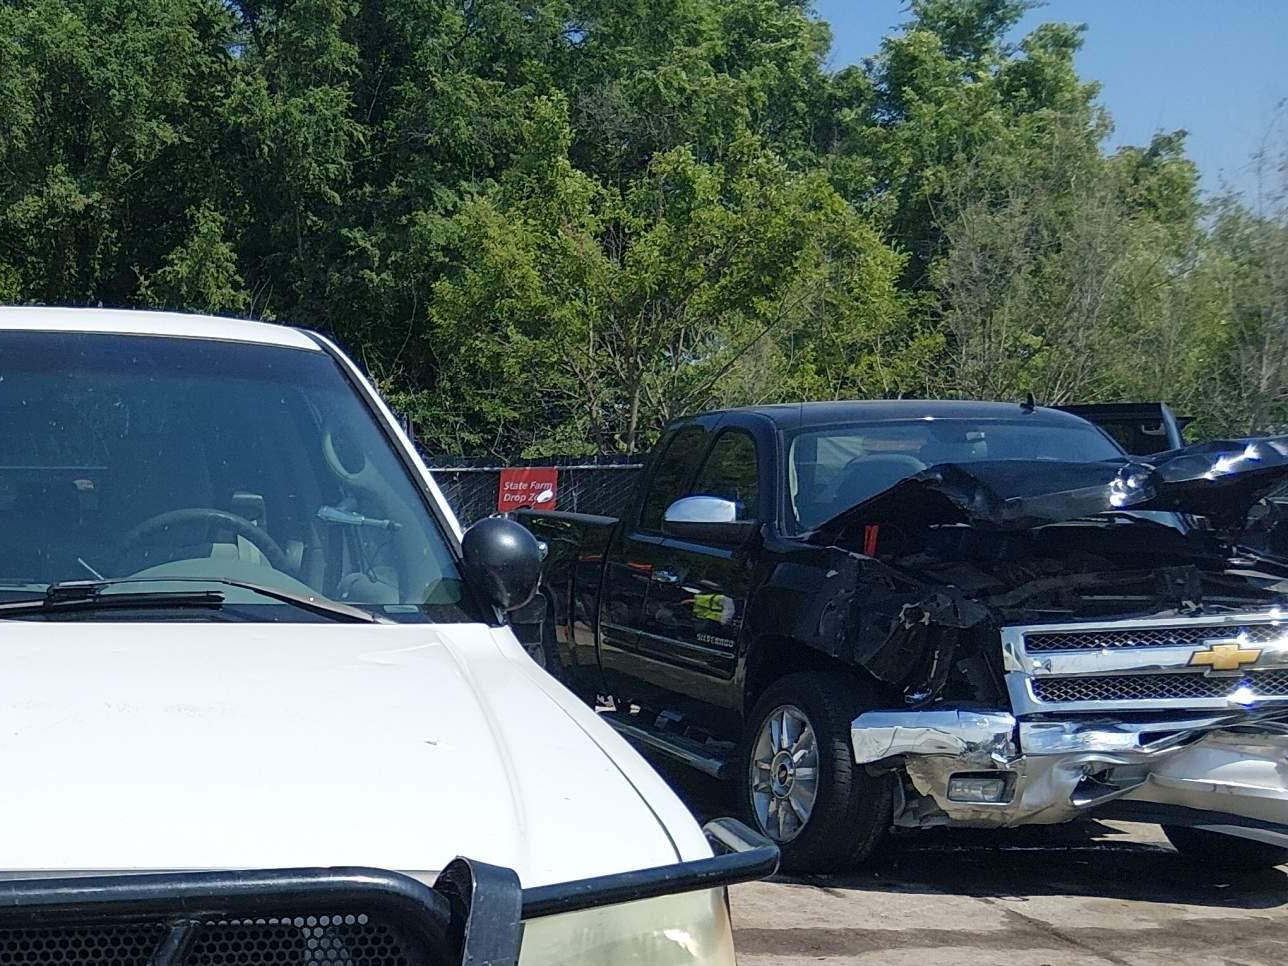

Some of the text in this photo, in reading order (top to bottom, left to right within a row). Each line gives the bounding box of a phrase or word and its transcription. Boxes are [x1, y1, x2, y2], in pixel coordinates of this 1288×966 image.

[503, 481, 553, 490] State Farm
[503, 493, 527, 504] Drop
